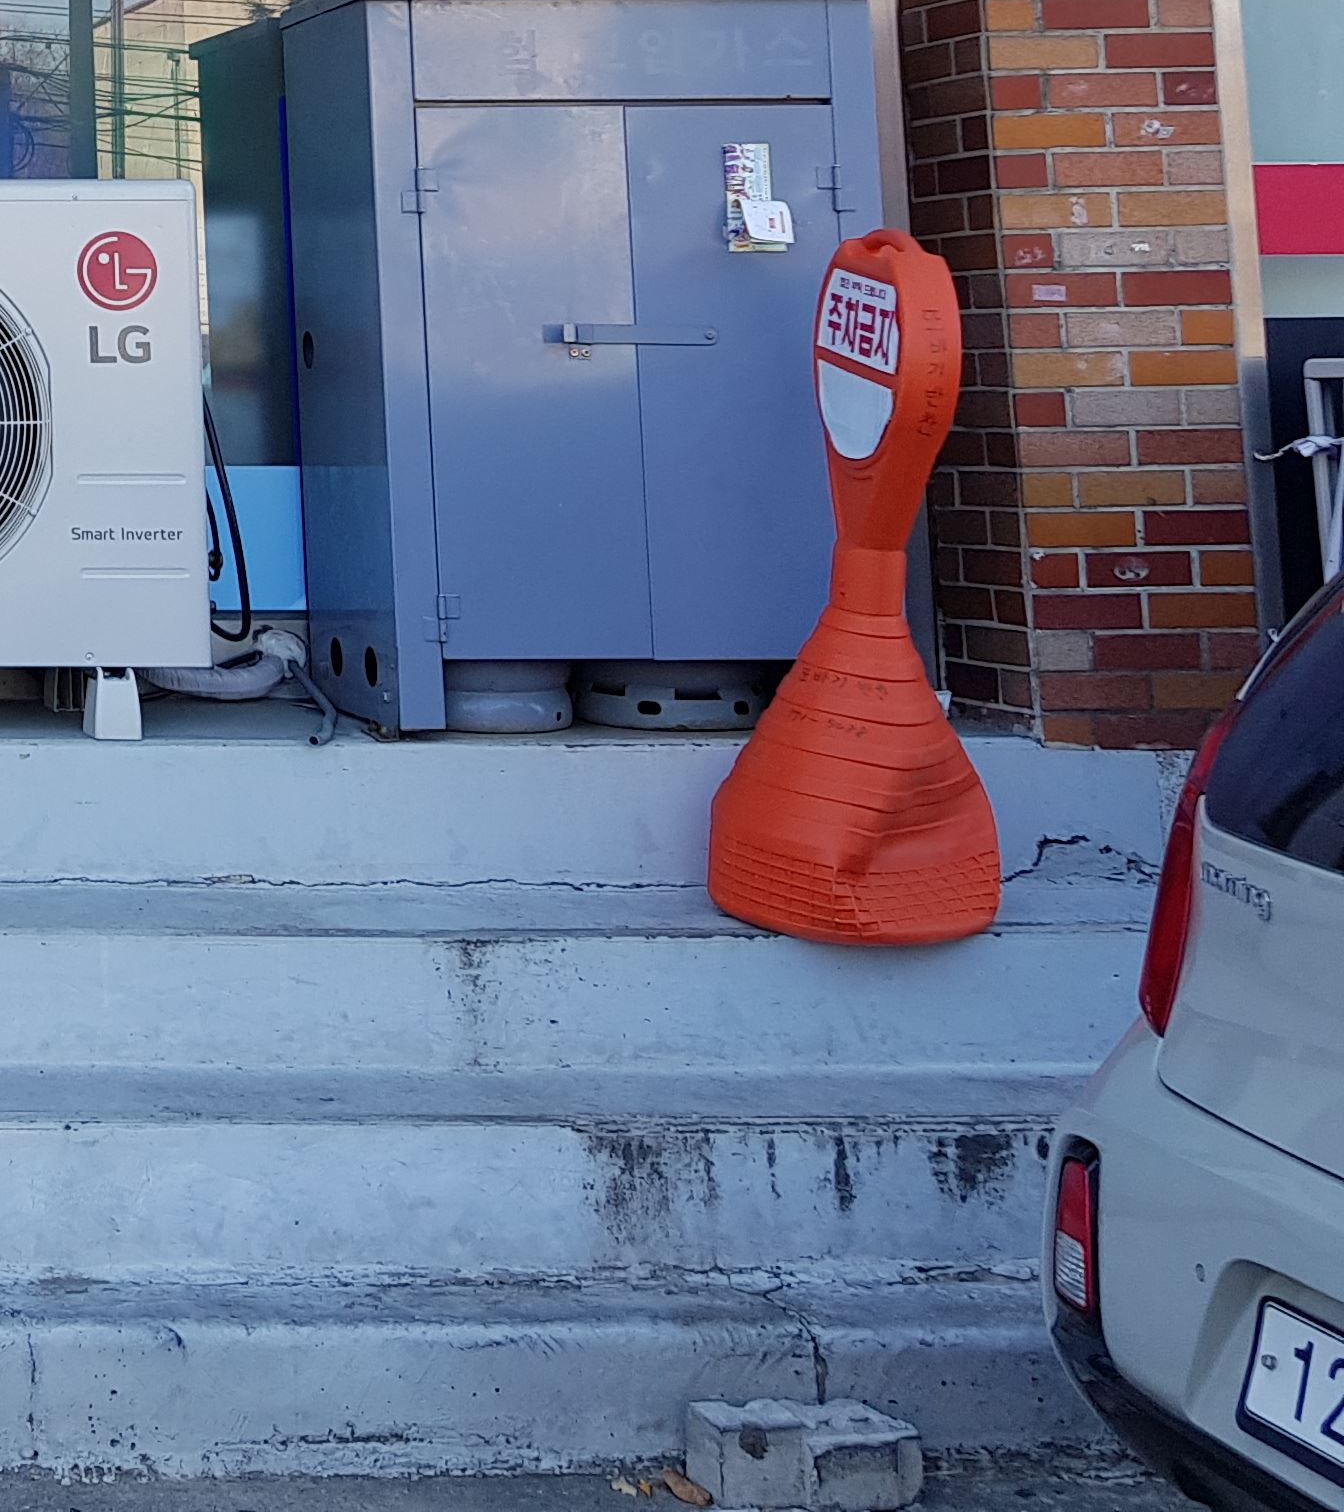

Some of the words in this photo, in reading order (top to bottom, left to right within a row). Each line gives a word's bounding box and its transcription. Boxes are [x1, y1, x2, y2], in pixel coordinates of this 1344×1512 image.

[88, 324, 152, 364] LG
[826, 291, 896, 367] 주차금지
[70, 527, 116, 541] Smart
[120, 527, 184, 541] Inverter
